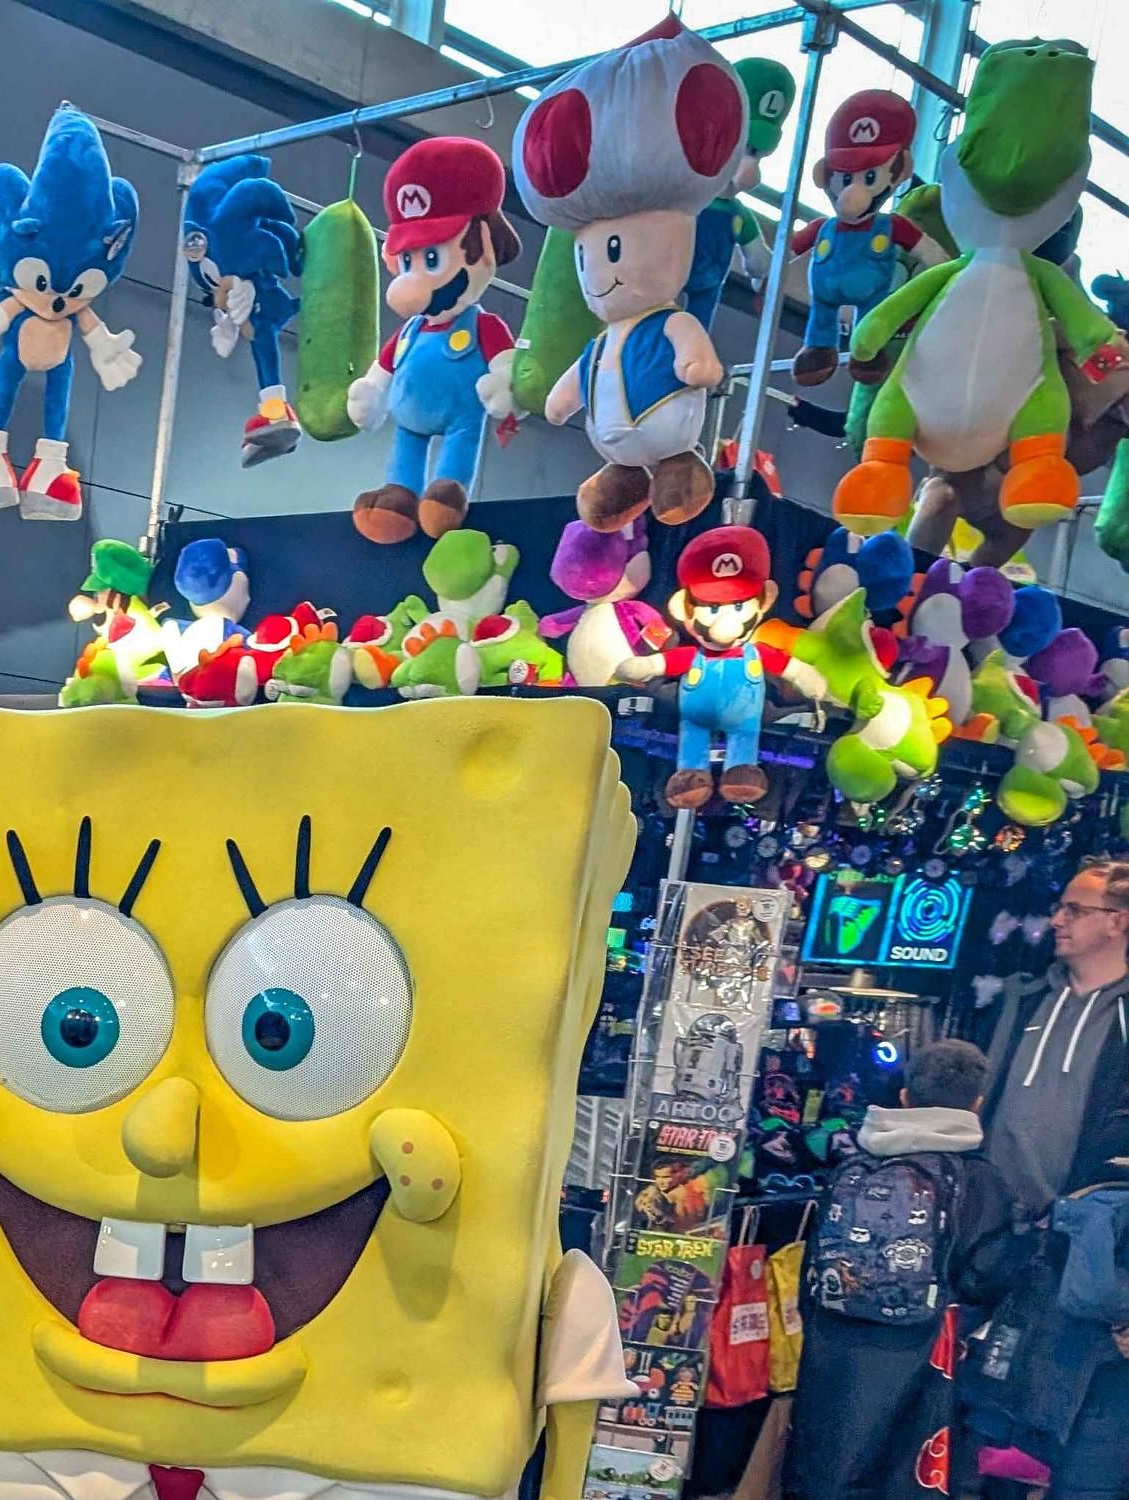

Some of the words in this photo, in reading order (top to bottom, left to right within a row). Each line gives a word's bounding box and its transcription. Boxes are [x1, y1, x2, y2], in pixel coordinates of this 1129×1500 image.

[765, 93, 778, 115] L
[852, 121, 876, 139] M
[400, 189, 428, 213] M
[715, 556, 739, 573] M
[890, 946, 949, 962] SOUND
[656, 1101, 733, 1122] ARTOO
[659, 1124, 698, 1148] STAR
[698, 1126, 738, 1151] TR
[637, 1239, 674, 1257] STAR
[675, 1239, 714, 1259] TREK
